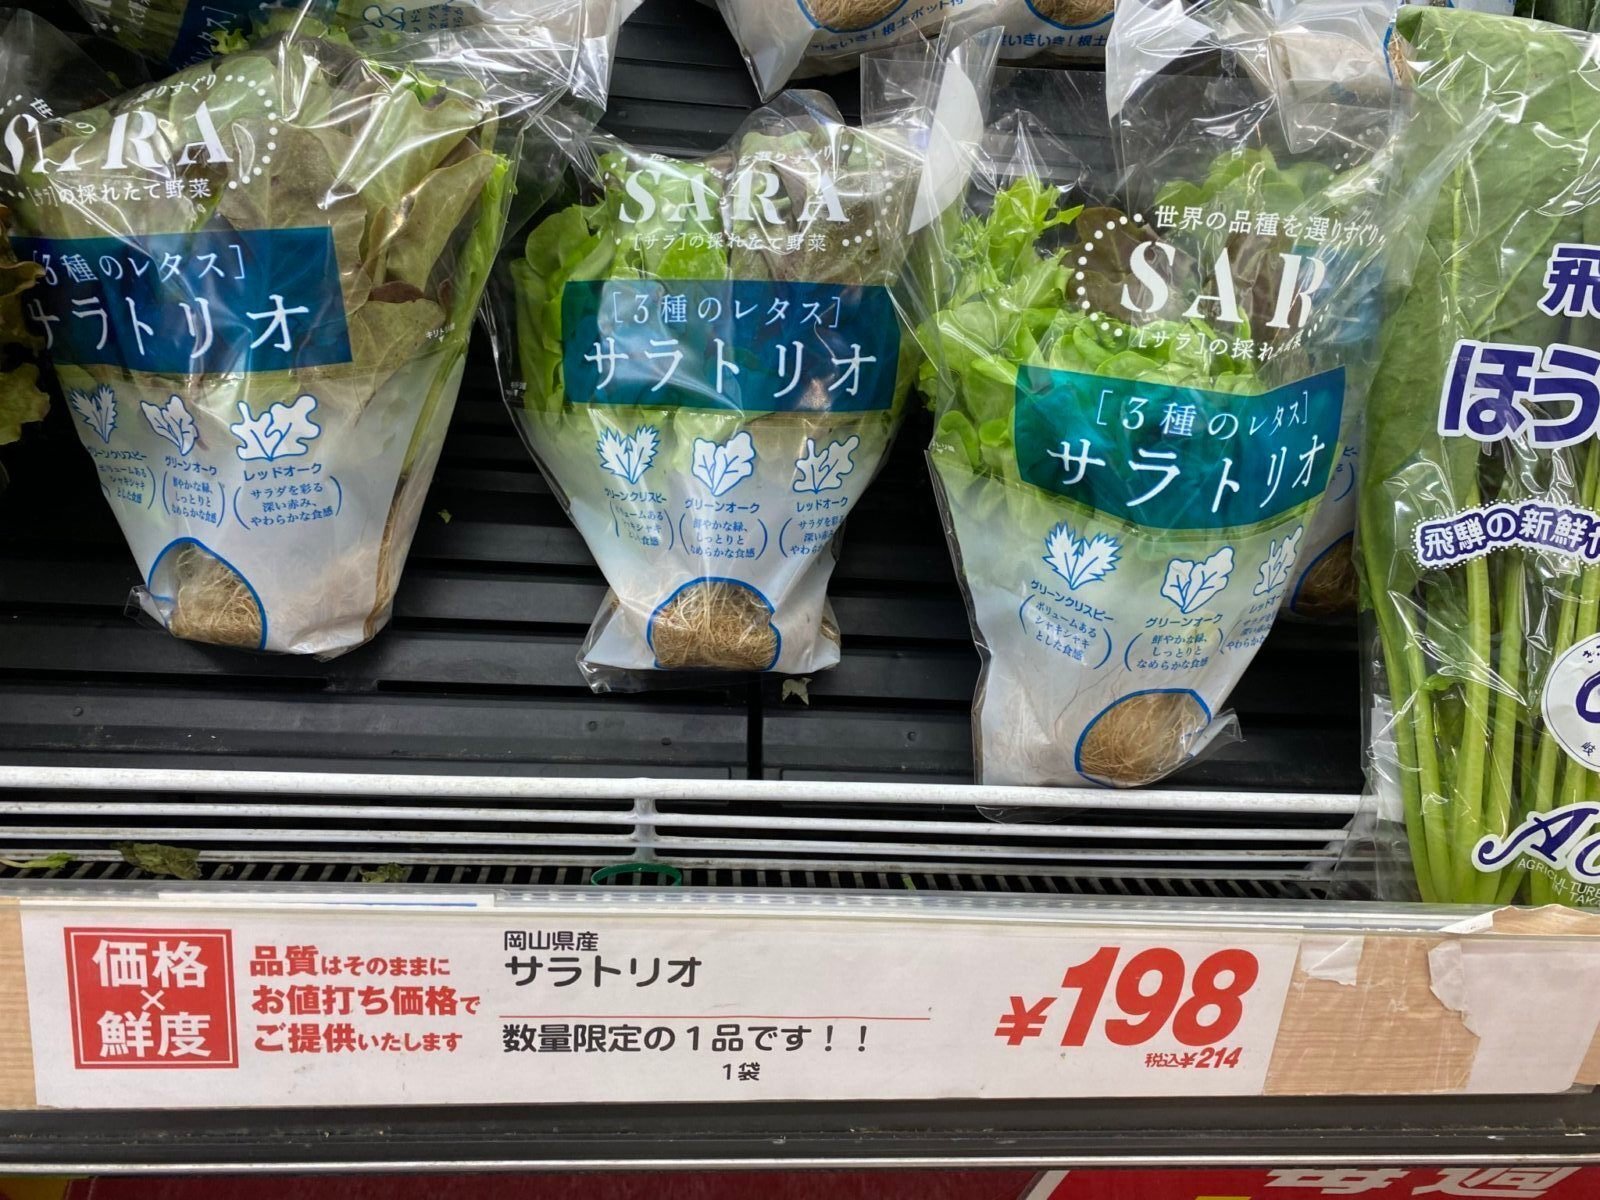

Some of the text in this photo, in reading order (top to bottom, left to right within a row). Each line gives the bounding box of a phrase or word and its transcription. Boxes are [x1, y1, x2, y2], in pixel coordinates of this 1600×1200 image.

[618, 168, 850, 225] SARA
[612, 291, 841, 329] [3種のレタス]
[584, 336, 878, 398] サラトリオ
[1096, 389, 1309, 441] [3種のレタス]
[243, 463, 322, 482] レッドオーク
[1046, 434, 1325, 513] サラトリオ
[250, 482, 324, 499] サラダを彩る
[684, 498, 760, 513] グリーンオーク
[796, 496, 848, 513] レッドオーク
[250, 505, 334, 527] やわらかな食感
[1030, 579, 1115, 622] グリーンクリスピー
[1145, 612, 1224, 629] グリーンオーク
[503, 930, 599, 951] 岡山県産
[92, 938, 209, 989] 価格
[249, 945, 450, 977] 品質はそのままに
[505, 955, 702, 988] サラトリオ
[251, 985, 481, 1016] お値打ち価格で
[994, 946, 1260, 1047] ¥198
[96, 1010, 211, 1059] 鮮度
[253, 1022, 463, 1053] ご提供いたします
[722, 1063, 760, 1081] 1袋
[1144, 1047, 1243, 1068] 税込¥214
